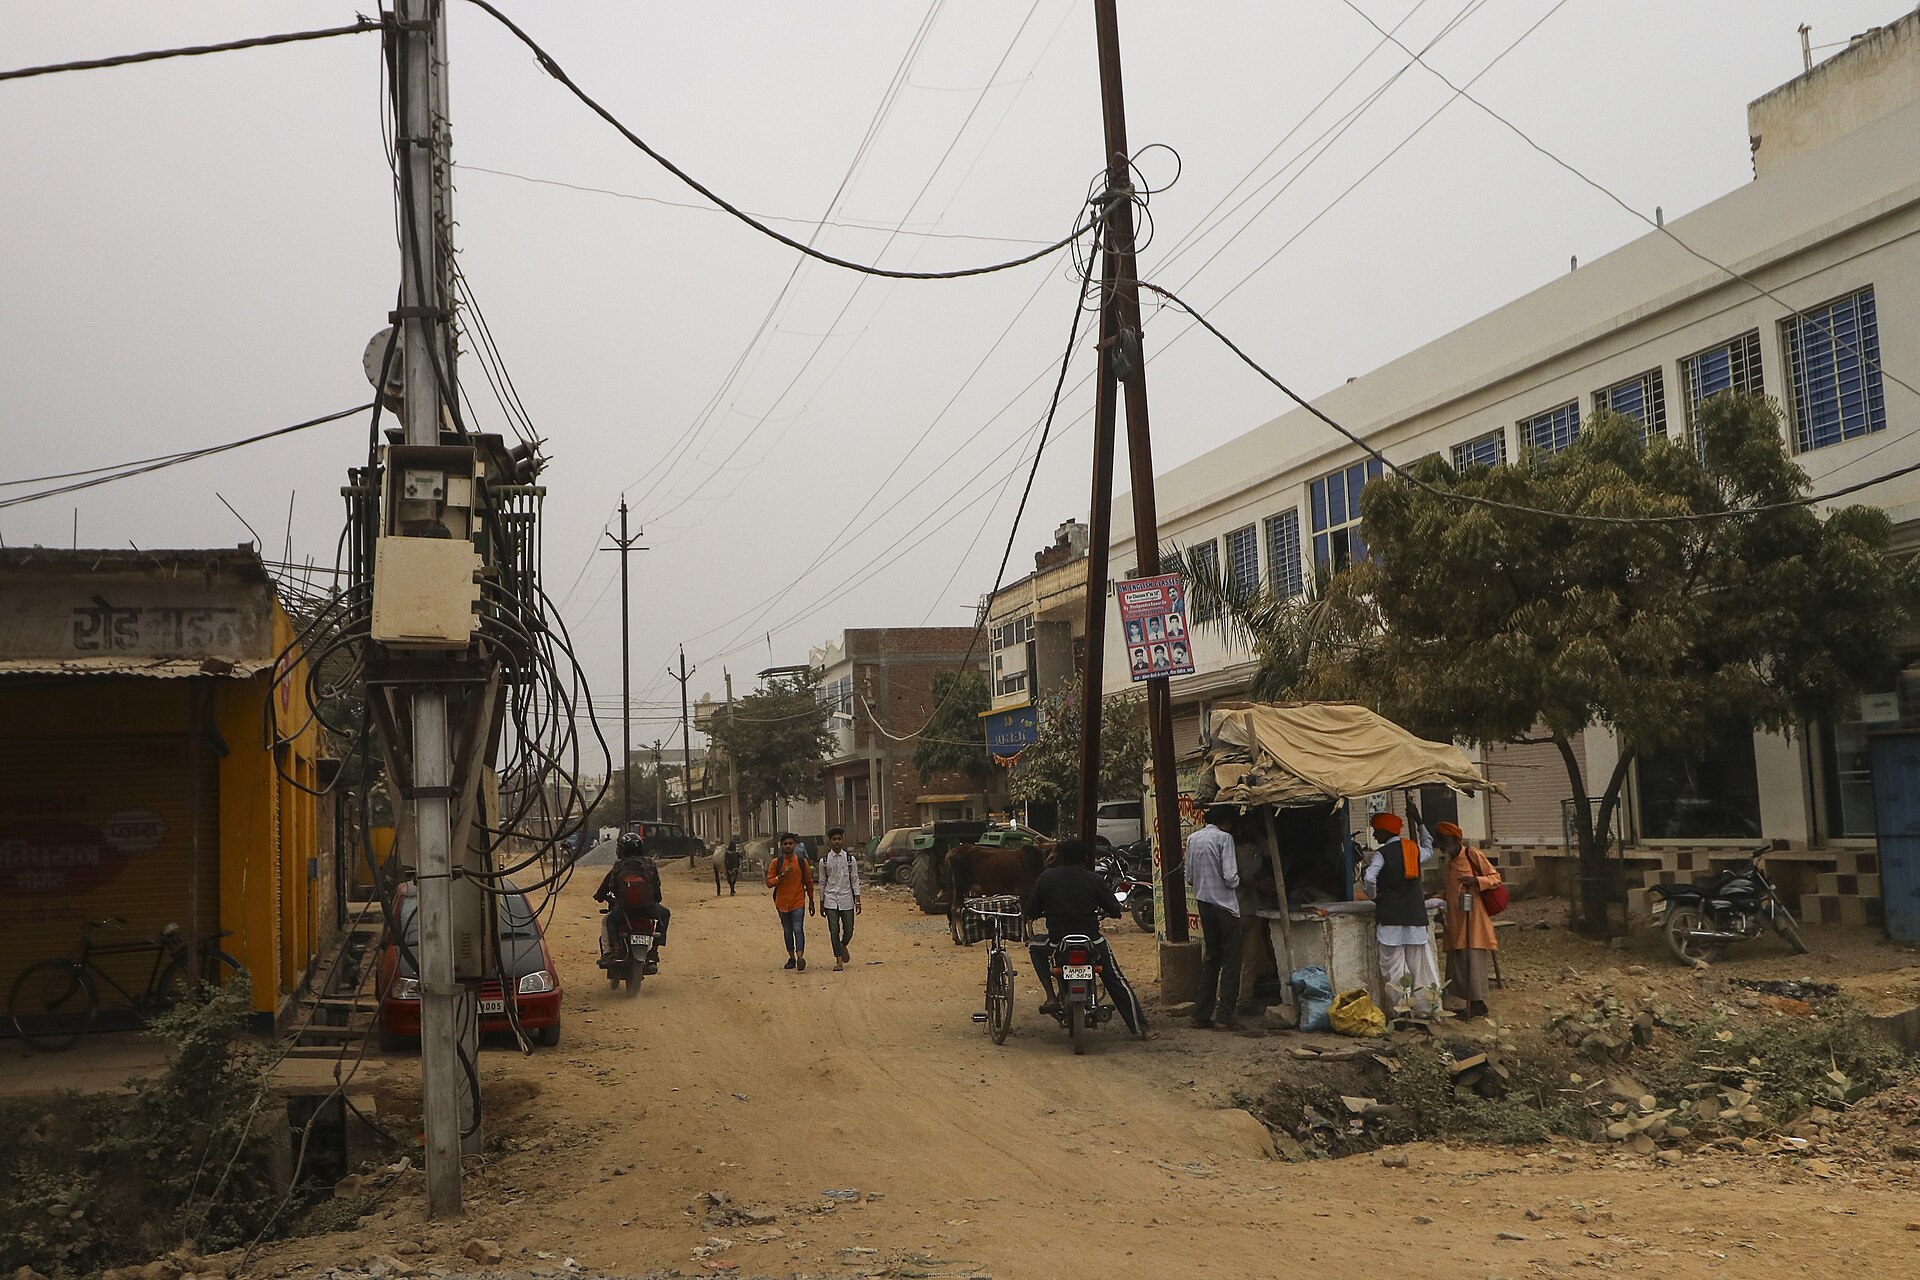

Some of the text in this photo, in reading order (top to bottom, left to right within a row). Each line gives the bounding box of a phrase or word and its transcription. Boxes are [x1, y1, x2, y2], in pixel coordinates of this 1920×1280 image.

[1118, 577, 1179, 593] OM ENGLISH CLASSES
[73, 595, 142, 650] रोड
